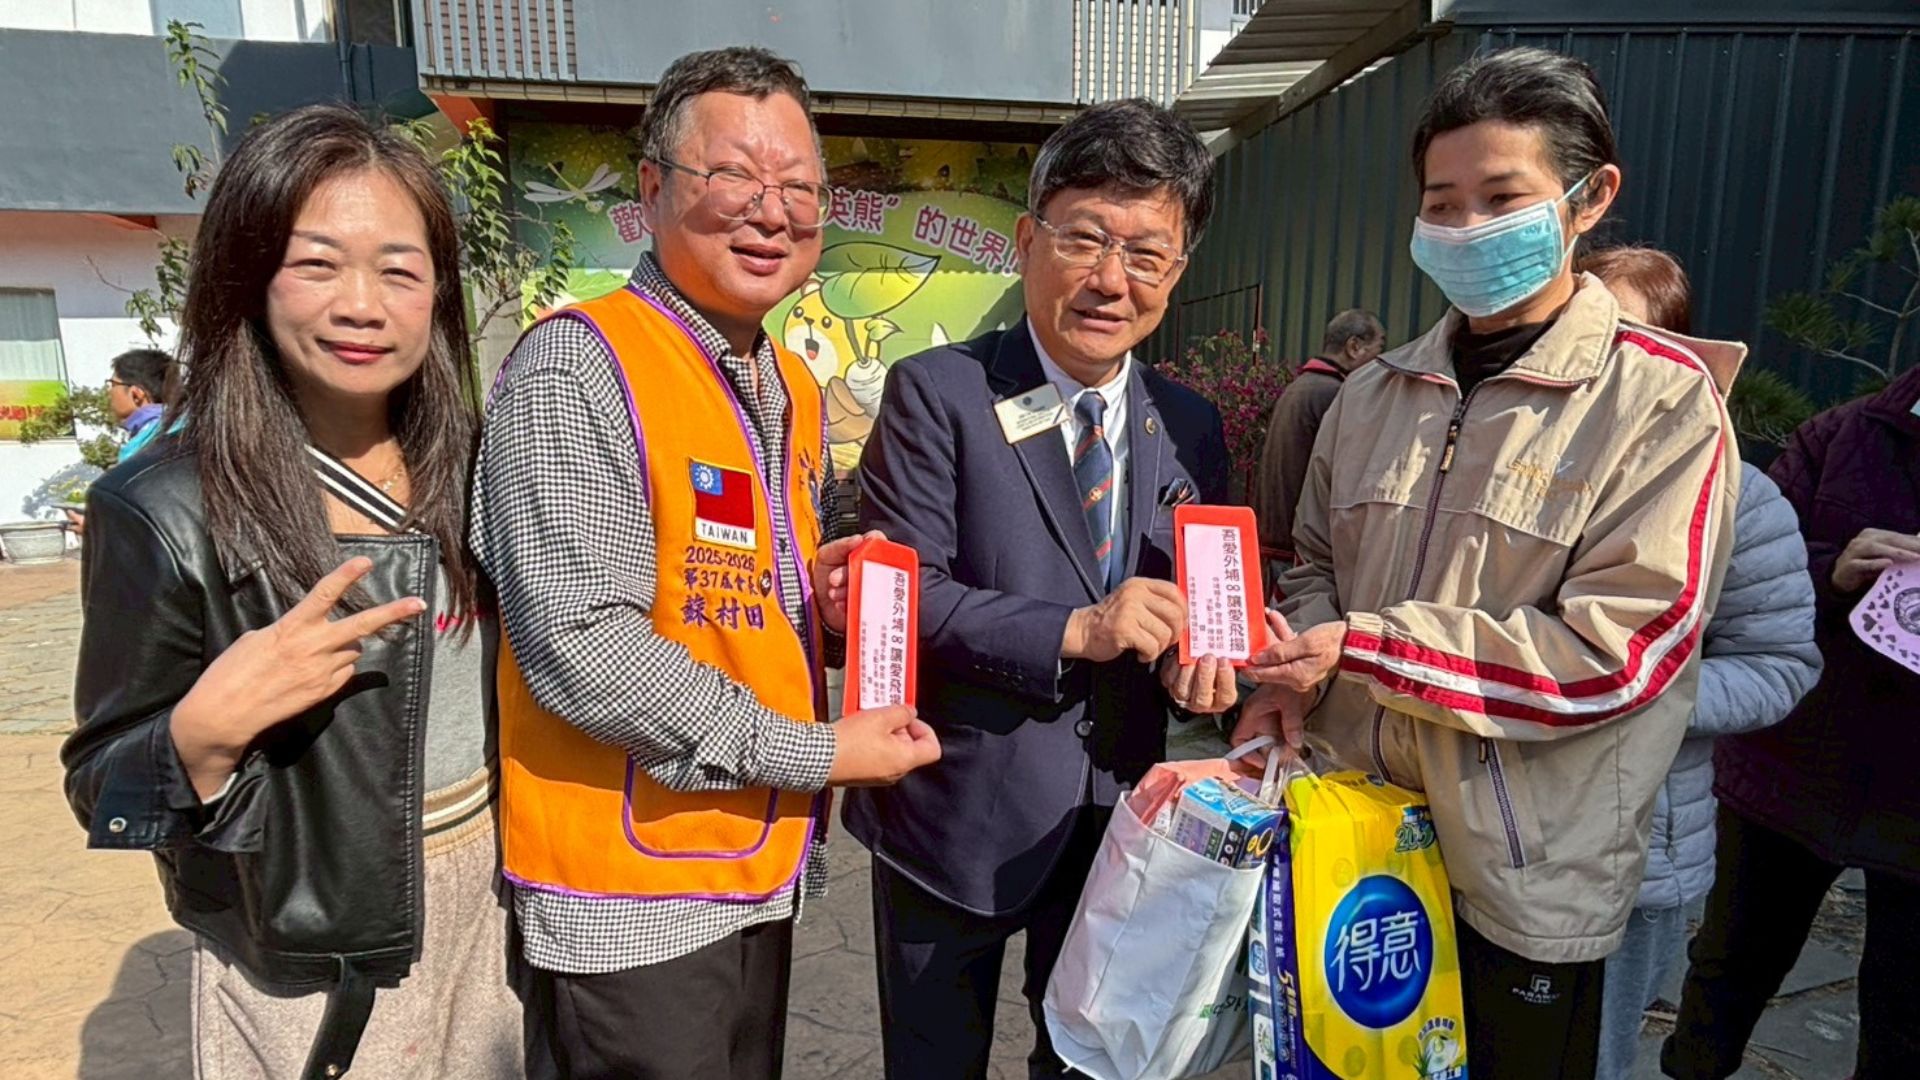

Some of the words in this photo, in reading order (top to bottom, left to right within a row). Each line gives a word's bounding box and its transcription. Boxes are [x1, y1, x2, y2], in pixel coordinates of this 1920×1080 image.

[701, 523, 748, 543] TAIWAN
[685, 545, 755, 572] 2025-2026
[680, 593, 763, 630] 蘇村田
[1330, 911, 1421, 993] 得意
